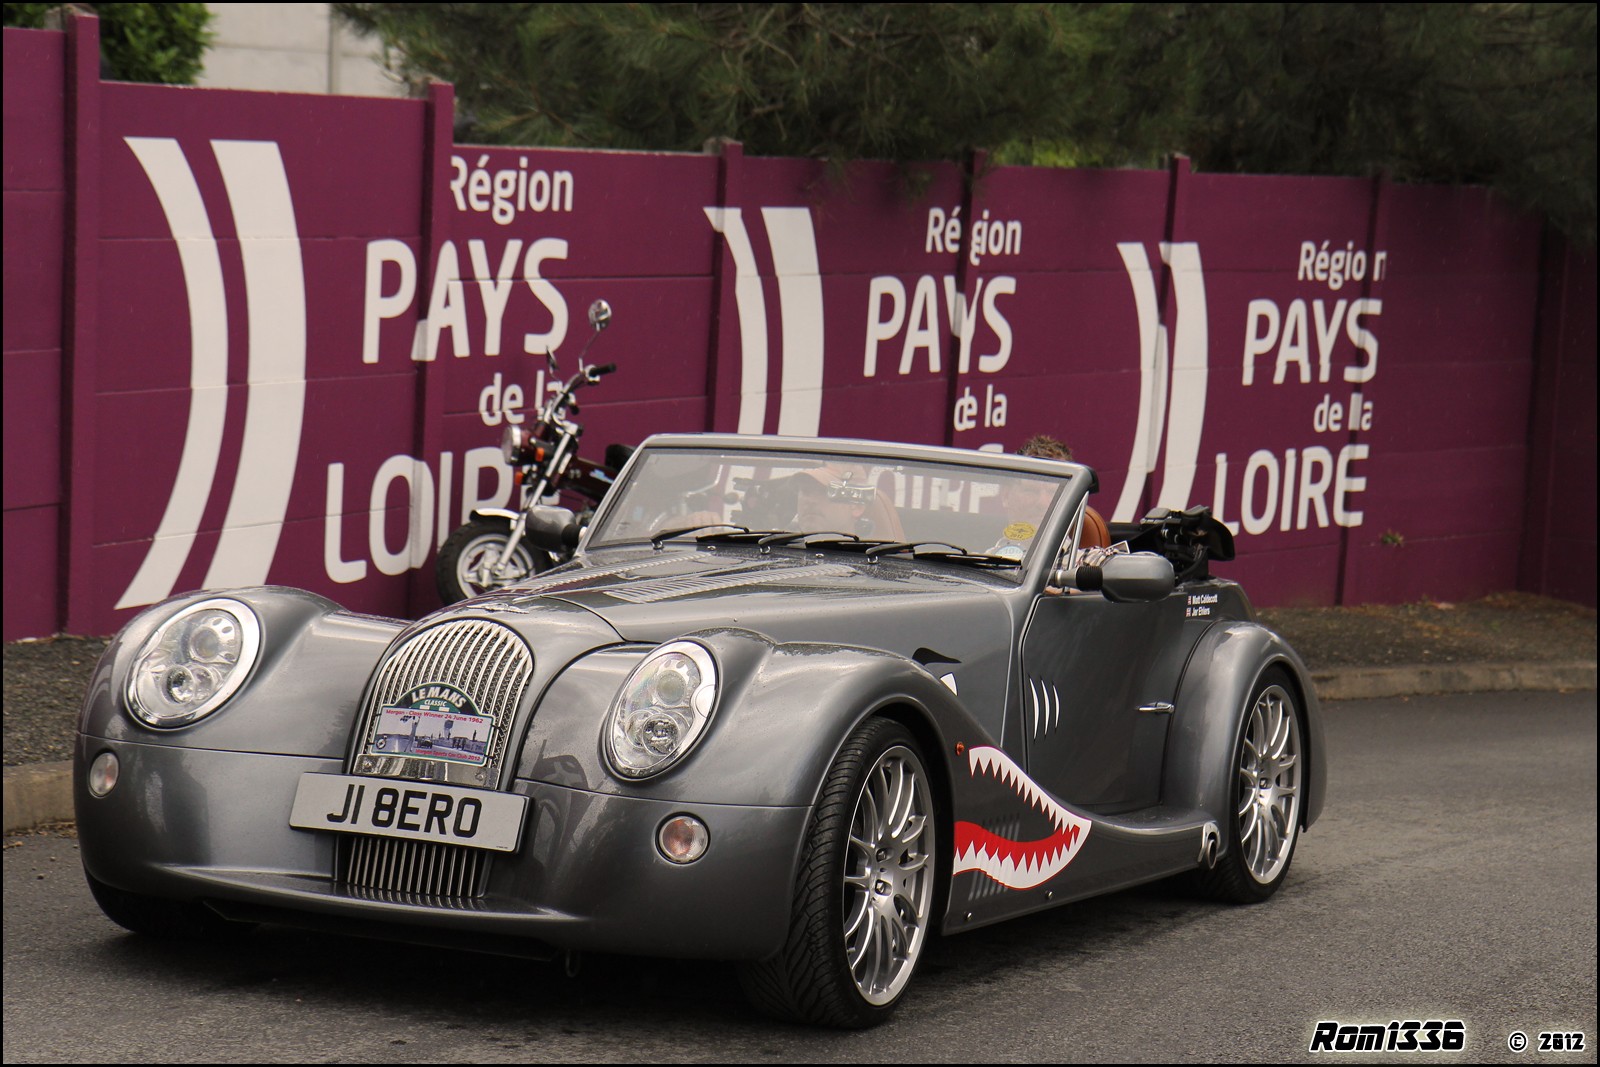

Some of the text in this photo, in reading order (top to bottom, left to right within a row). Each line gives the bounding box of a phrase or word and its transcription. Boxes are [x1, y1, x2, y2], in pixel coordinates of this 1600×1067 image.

[450, 154, 574, 225] Région
[925, 206, 1022, 266] Région
[1297, 240, 1387, 291] Région
[362, 237, 569, 364] PAYS
[863, 274, 1017, 378] PAYS
[1242, 298, 1383, 386] PAYS
[478, 372, 525, 427] de
[953, 383, 1008, 432] de la
[1313, 392, 1373, 433] de la
[1212, 444, 1370, 537] LOIRE
[423, 711, 443, 719] Winner
[424, 699, 448, 707] CLASSIC
